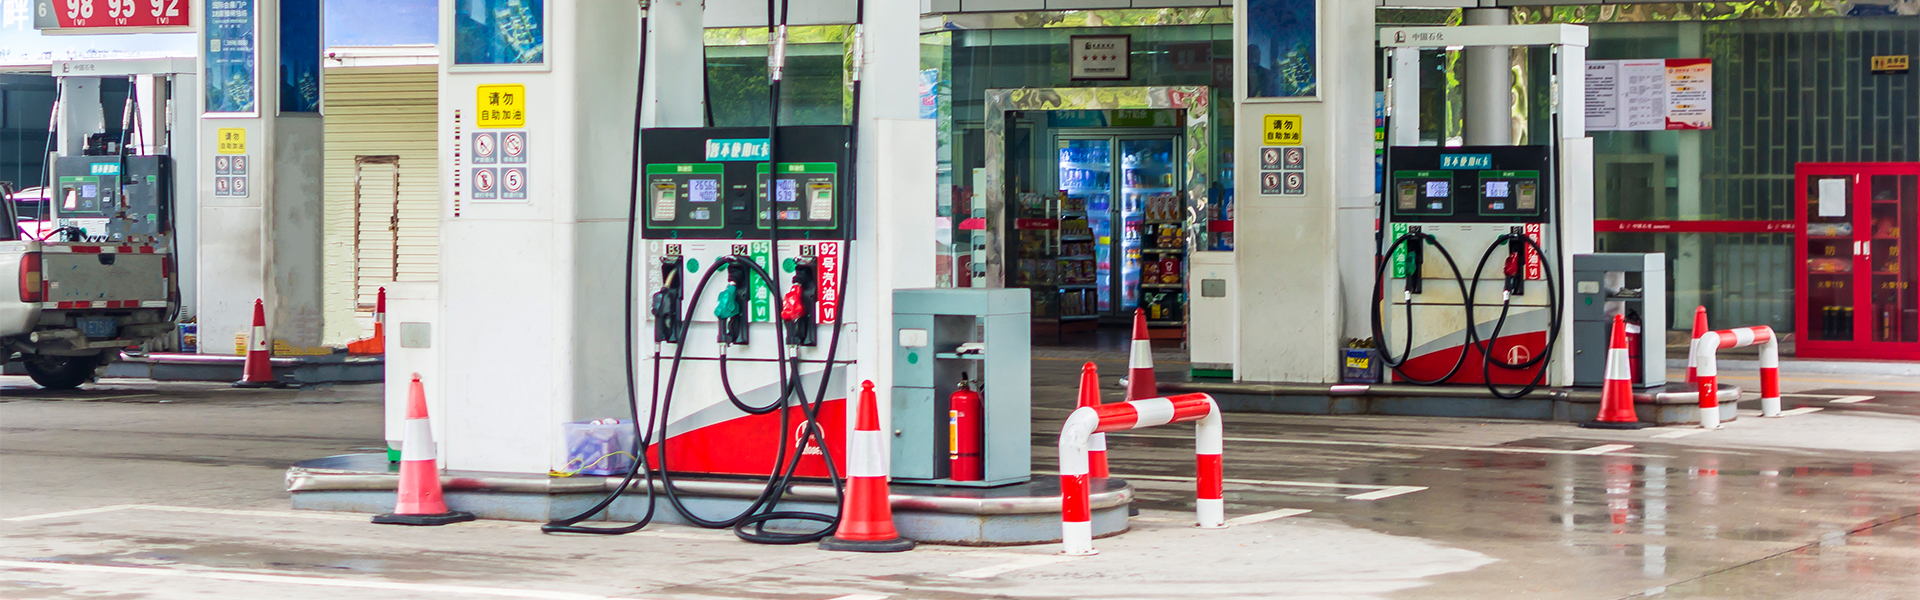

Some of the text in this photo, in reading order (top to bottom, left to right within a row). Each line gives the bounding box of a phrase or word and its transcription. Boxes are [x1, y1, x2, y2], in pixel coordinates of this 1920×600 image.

[67, 0, 179, 18] 98 95 92
[1412, 32, 1445, 41] 中国石化
[488, 92, 514, 106] 请勿
[482, 110, 522, 121] 自助加油
[1273, 120, 1294, 130] 请勿
[1267, 132, 1299, 140] 自助加油
[510, 175, 518, 186] 5
[1290, 177, 1297, 186] 5
[671, 230, 678, 238] 3
[736, 230, 744, 239] 2
[804, 230, 810, 239] 1
[669, 245, 680, 254] B3
[733, 245, 746, 255] B2
[803, 245, 814, 255] B1
